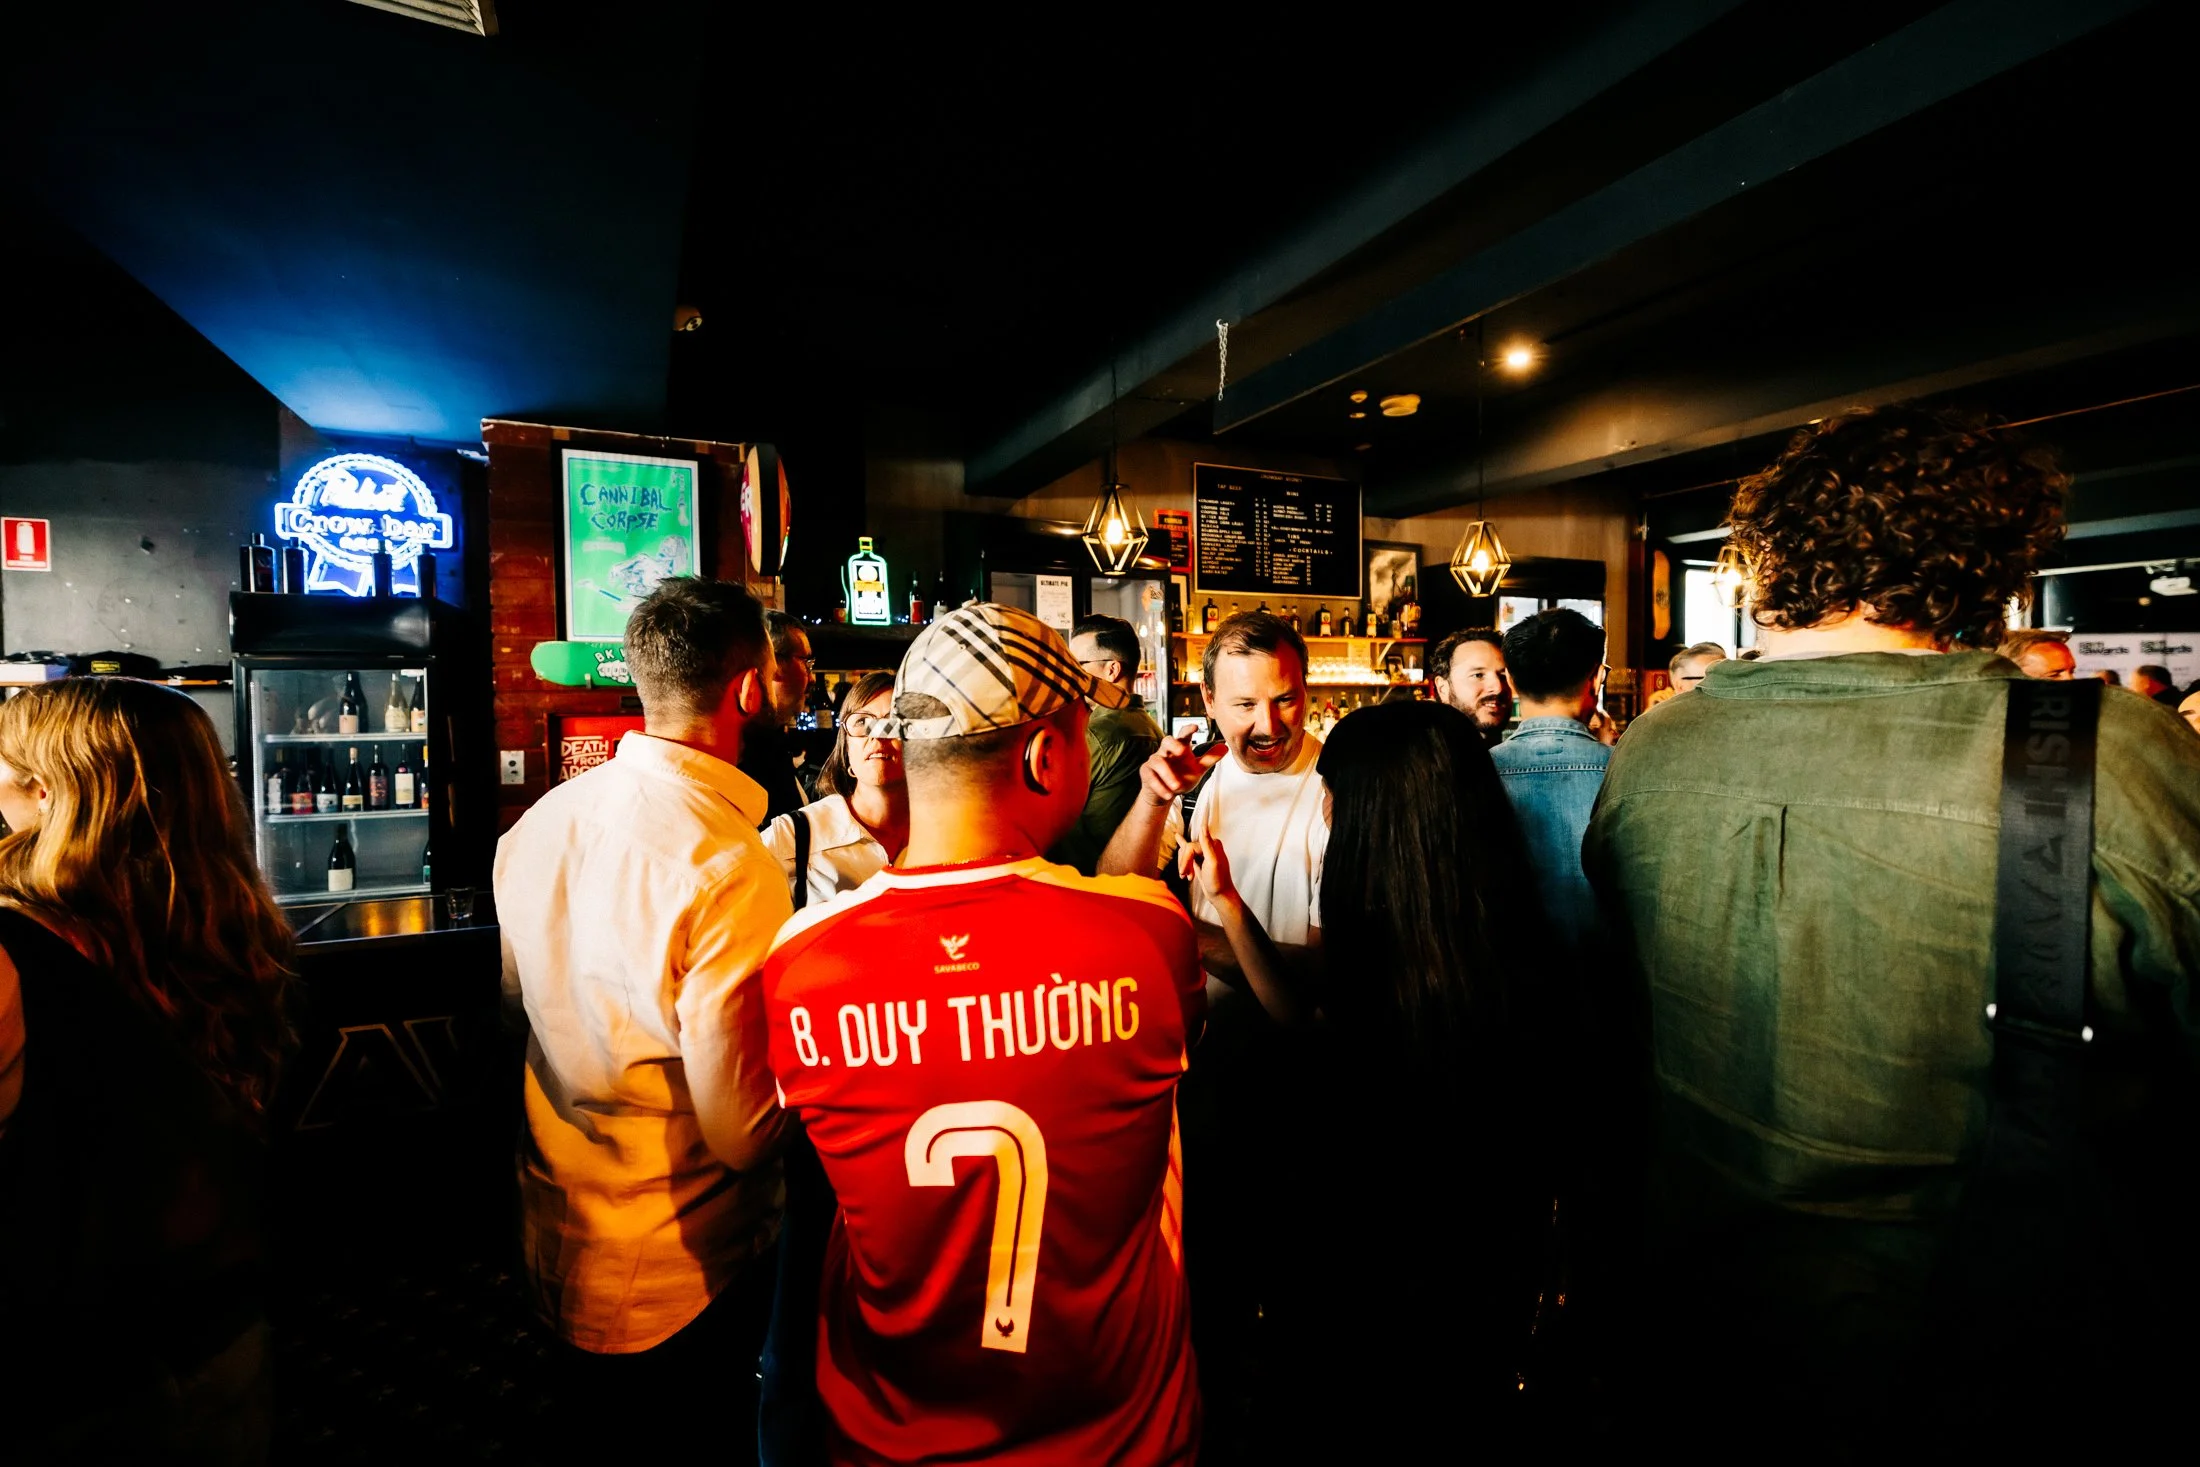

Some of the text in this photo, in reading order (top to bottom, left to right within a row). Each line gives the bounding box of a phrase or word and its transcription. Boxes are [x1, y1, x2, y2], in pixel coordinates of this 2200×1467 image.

[580, 483, 672, 511] CANNIBAL
[591, 510, 658, 533] CORPSE
[561, 740, 609, 757] DEATH
[566, 755, 608, 766] FROM
[838, 999, 927, 1067] DUY
[947, 973, 1139, 1062] THƯỜNG
[904, 1100, 1049, 1353] 7
